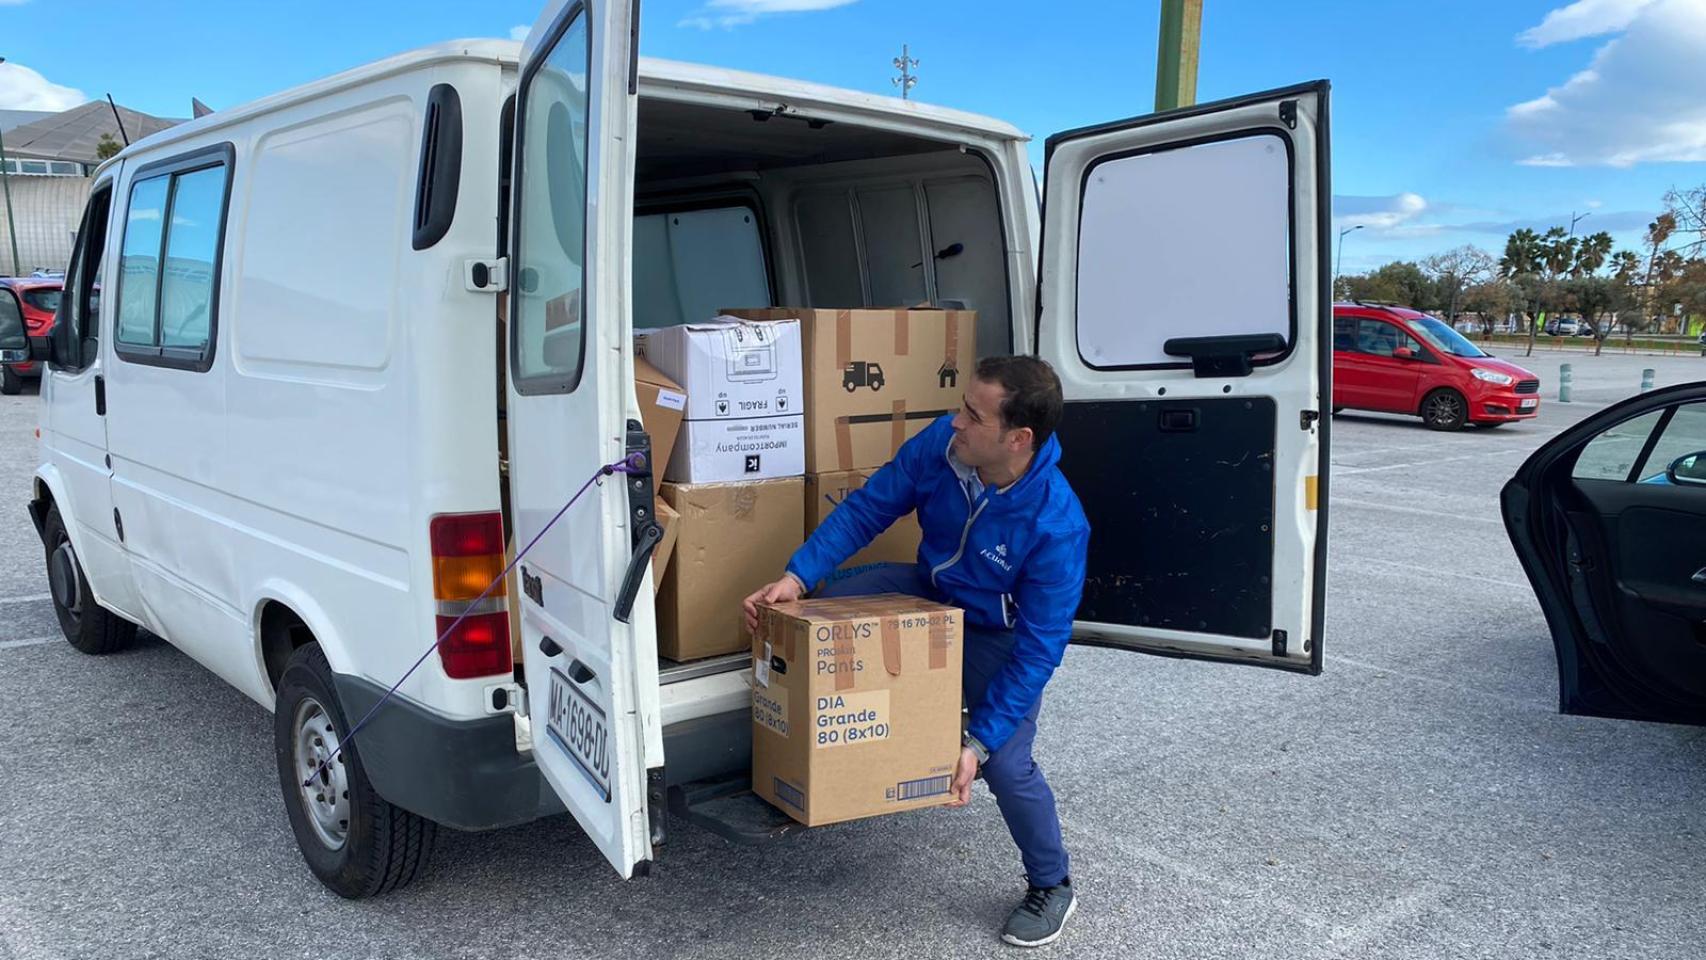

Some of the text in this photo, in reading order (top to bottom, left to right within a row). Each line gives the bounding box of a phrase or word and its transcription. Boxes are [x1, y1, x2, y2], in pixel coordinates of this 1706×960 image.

[738, 400, 768, 411] FRAGIL
[750, 424, 776, 432] NUMBER
[901, 619, 913, 628] 16
[944, 614, 955, 625] PL
[817, 660, 864, 675] Pants
[817, 695, 845, 710] DIA
[817, 709, 877, 727] Grande
[817, 722, 889, 744] 80 (8x10)
